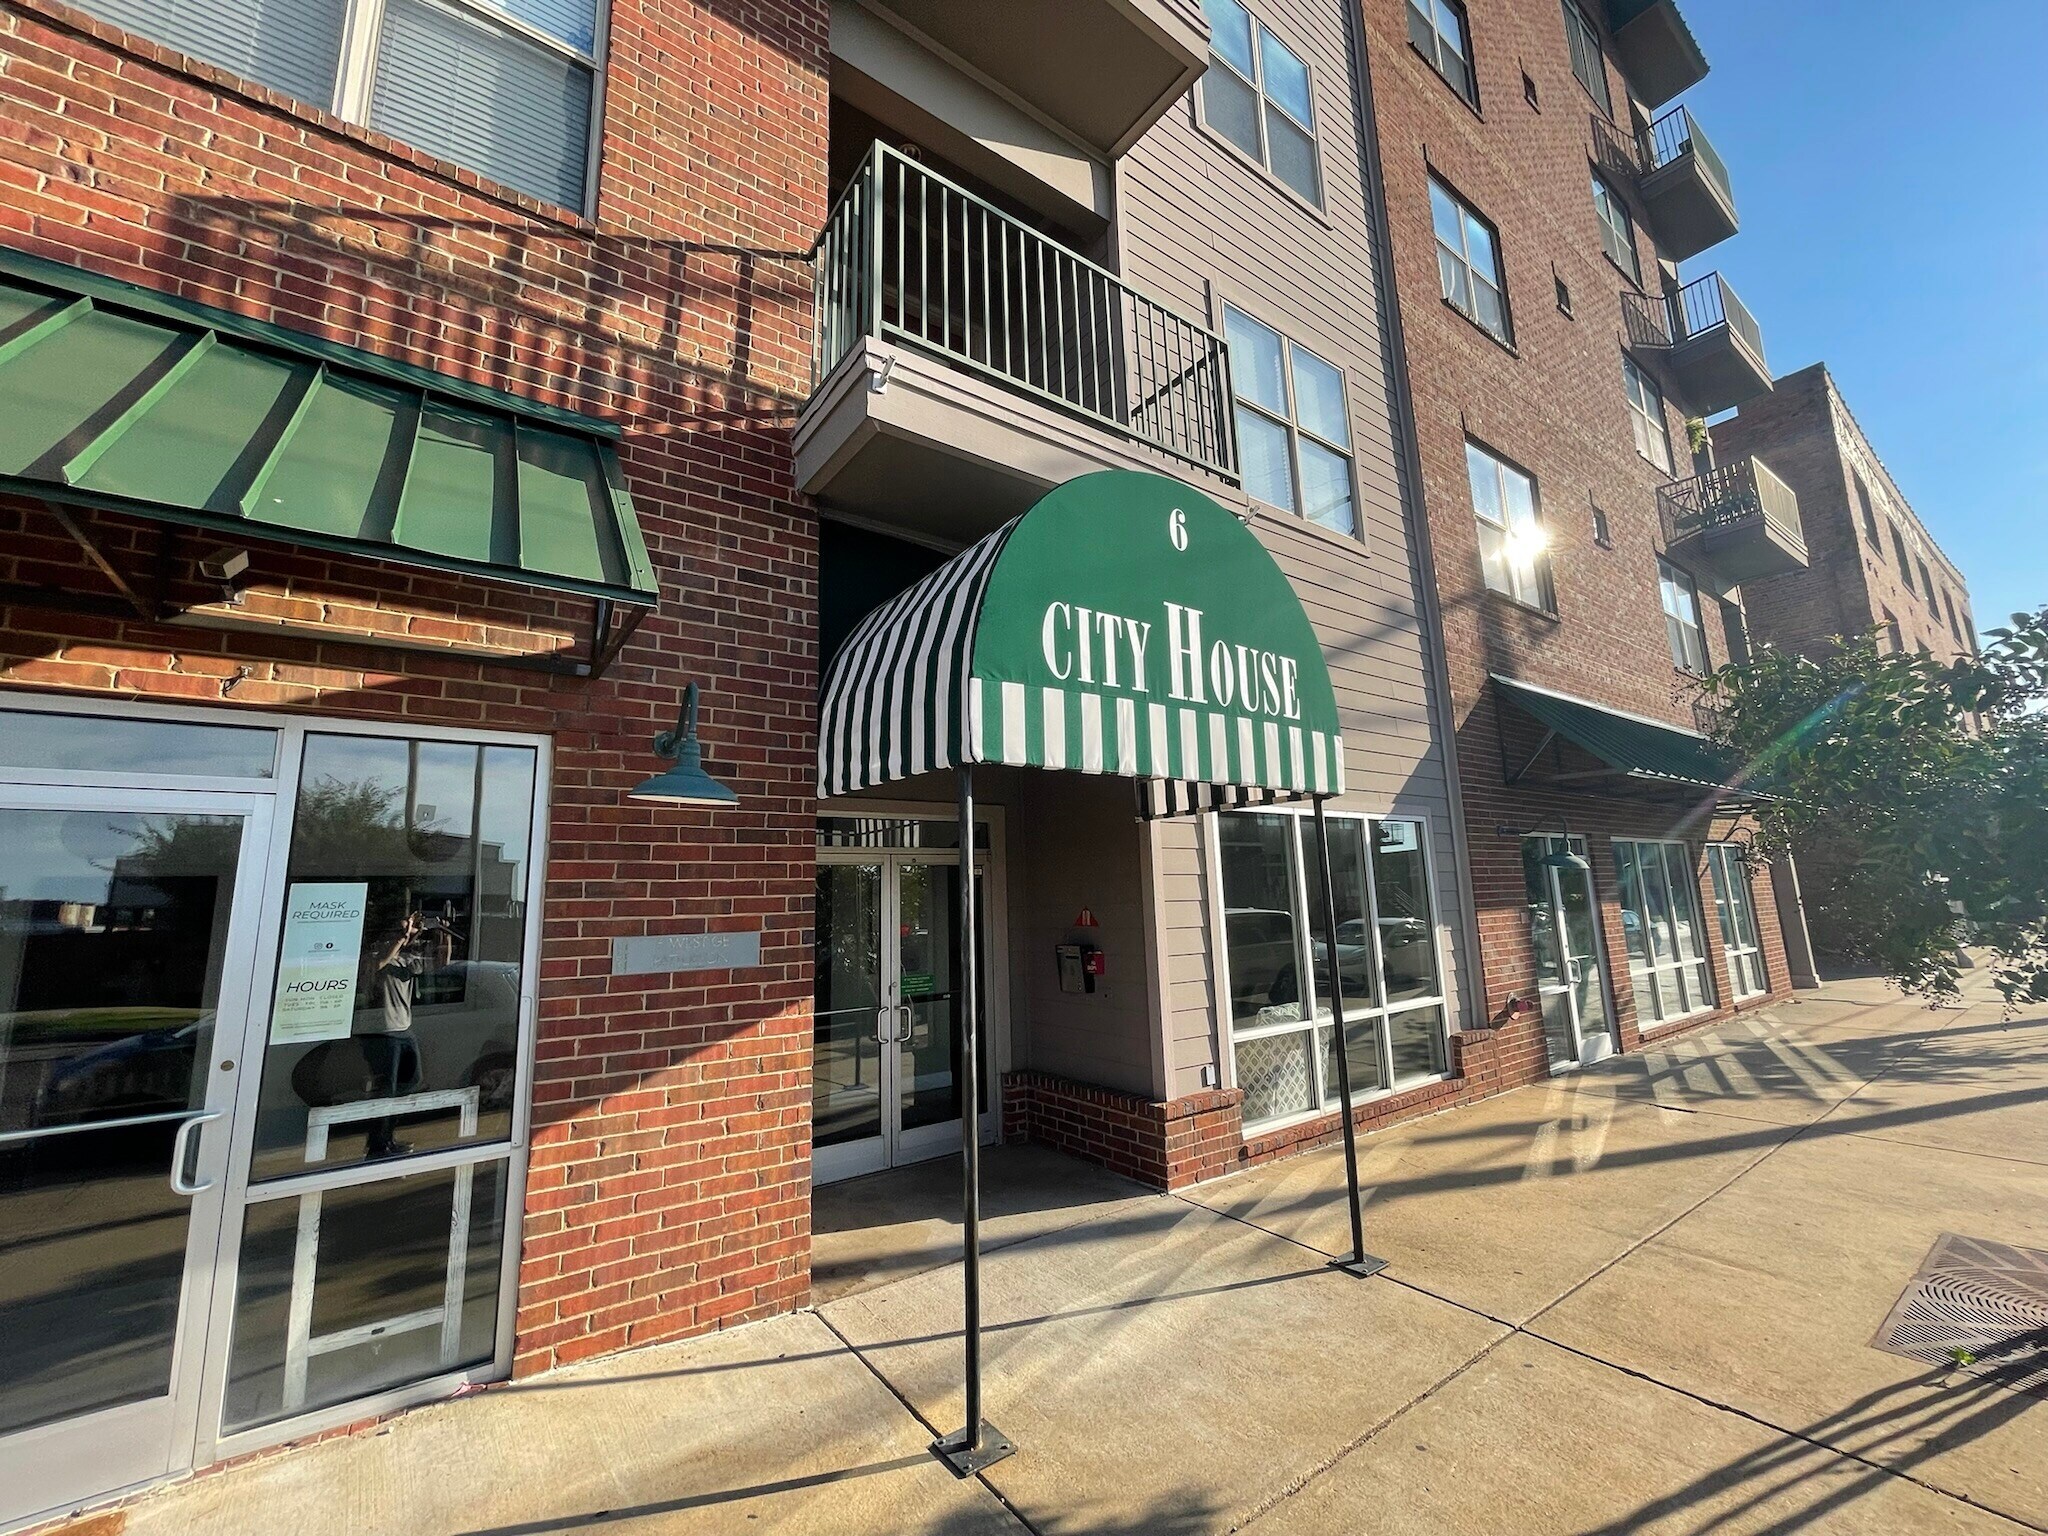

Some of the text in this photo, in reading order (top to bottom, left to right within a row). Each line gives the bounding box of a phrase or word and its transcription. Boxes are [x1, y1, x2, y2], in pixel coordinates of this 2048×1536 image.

[1168, 508, 1188, 551] 6
[1042, 601, 1300, 720] CITY HOUSE
[309, 901, 347, 910] MASK
[292, 910, 360, 919] REQUIRED
[286, 979, 349, 993] HOURS
